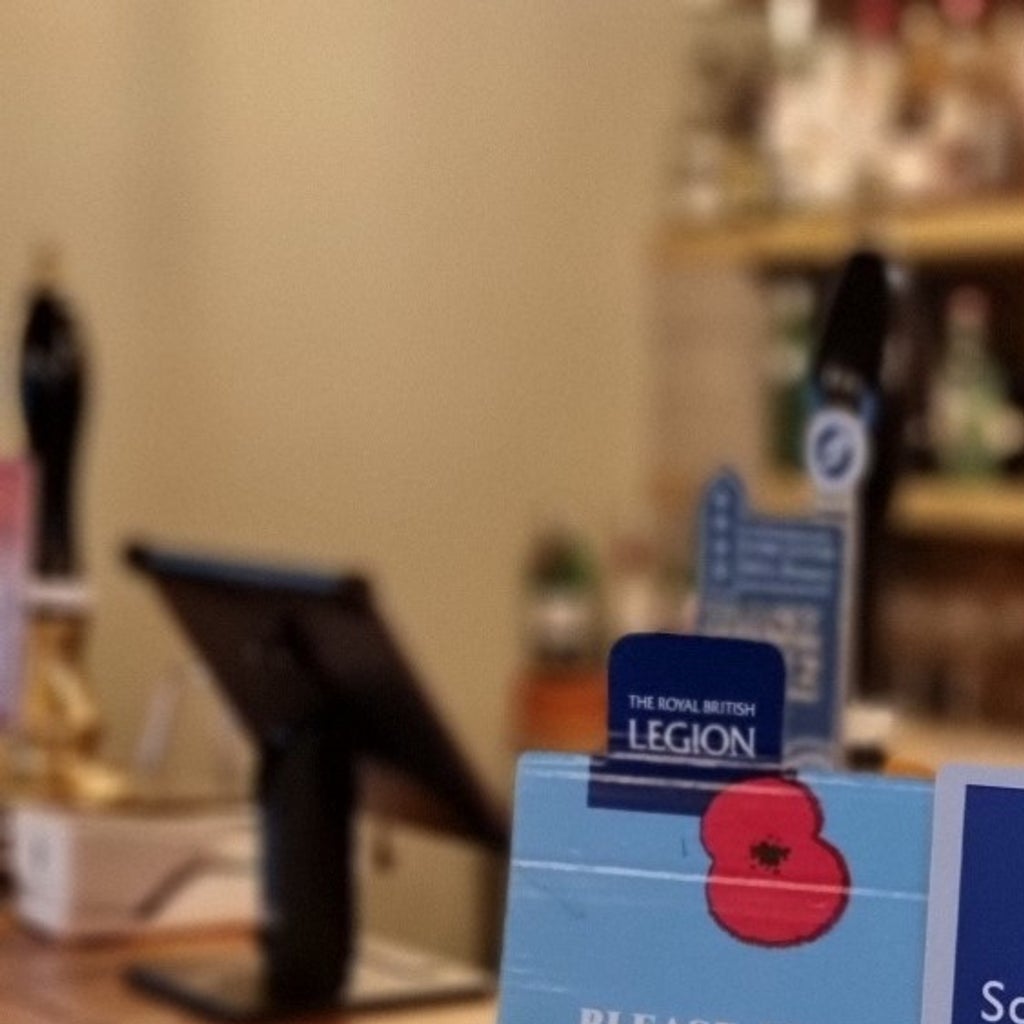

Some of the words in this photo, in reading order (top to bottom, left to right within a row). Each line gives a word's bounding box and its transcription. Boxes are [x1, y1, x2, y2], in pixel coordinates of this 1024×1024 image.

[628, 695, 654, 710] THE
[658, 698, 700, 713] ROYAL
[703, 700, 756, 717] BRITISH
[628, 718, 756, 758] LEGION
